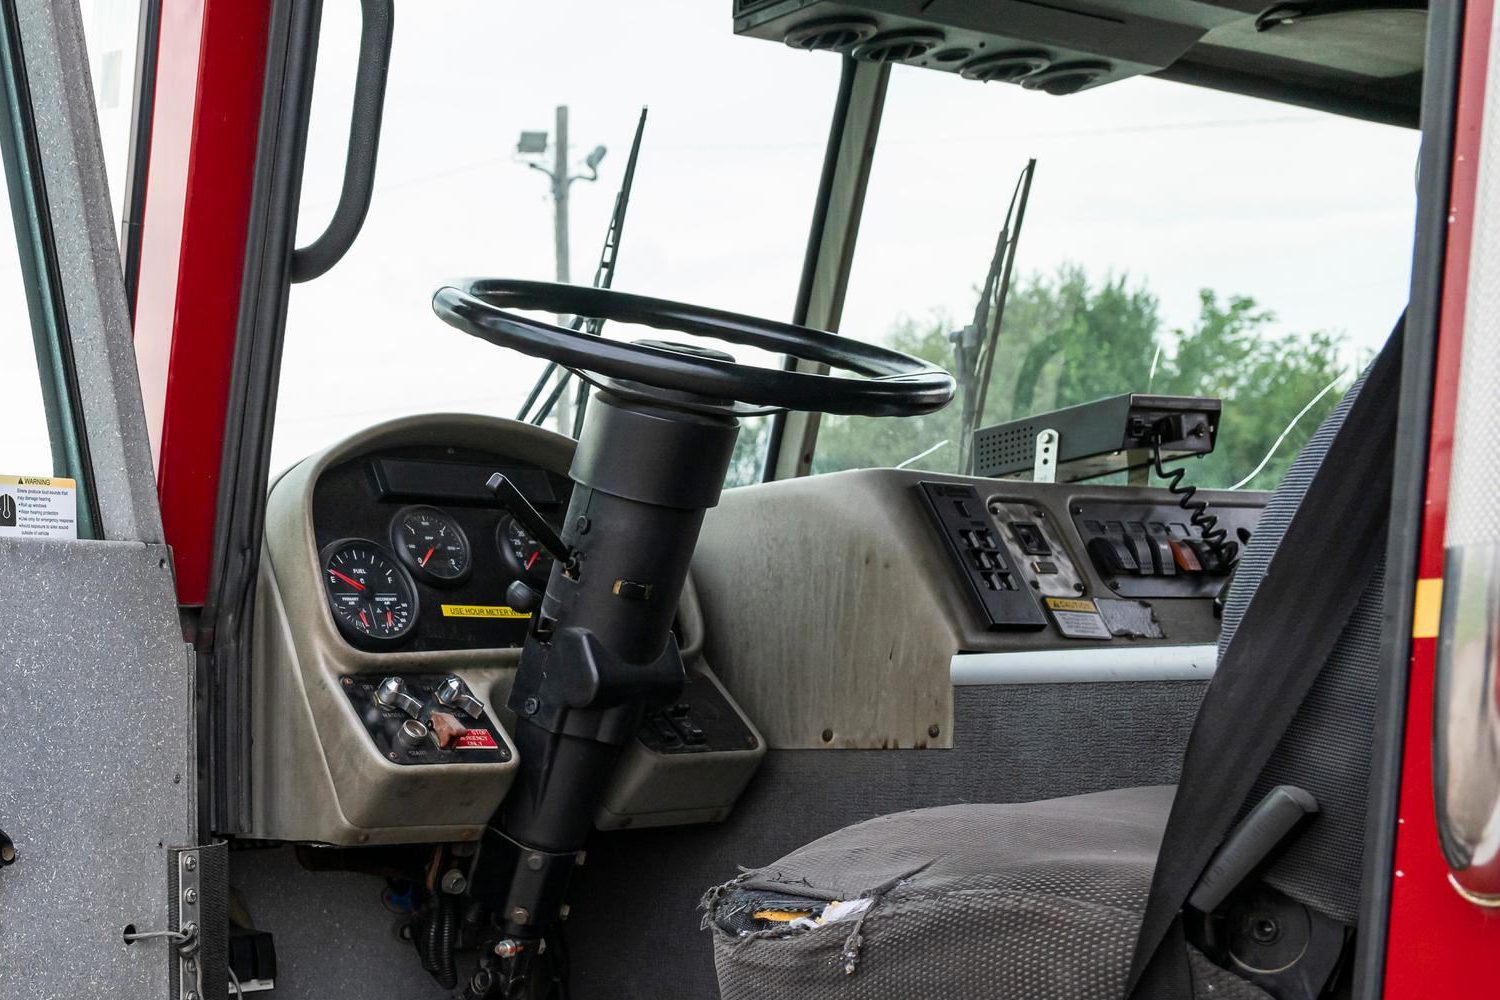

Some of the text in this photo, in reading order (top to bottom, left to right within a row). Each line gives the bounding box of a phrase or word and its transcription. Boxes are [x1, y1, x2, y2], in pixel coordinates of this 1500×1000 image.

[25, 477, 51, 486] WARNING
[330, 576, 336, 584] E
[387, 576, 393, 584] F
[450, 607, 464, 615] USE
[466, 608, 485, 616] HOUR
[486, 608, 508, 616] METER
